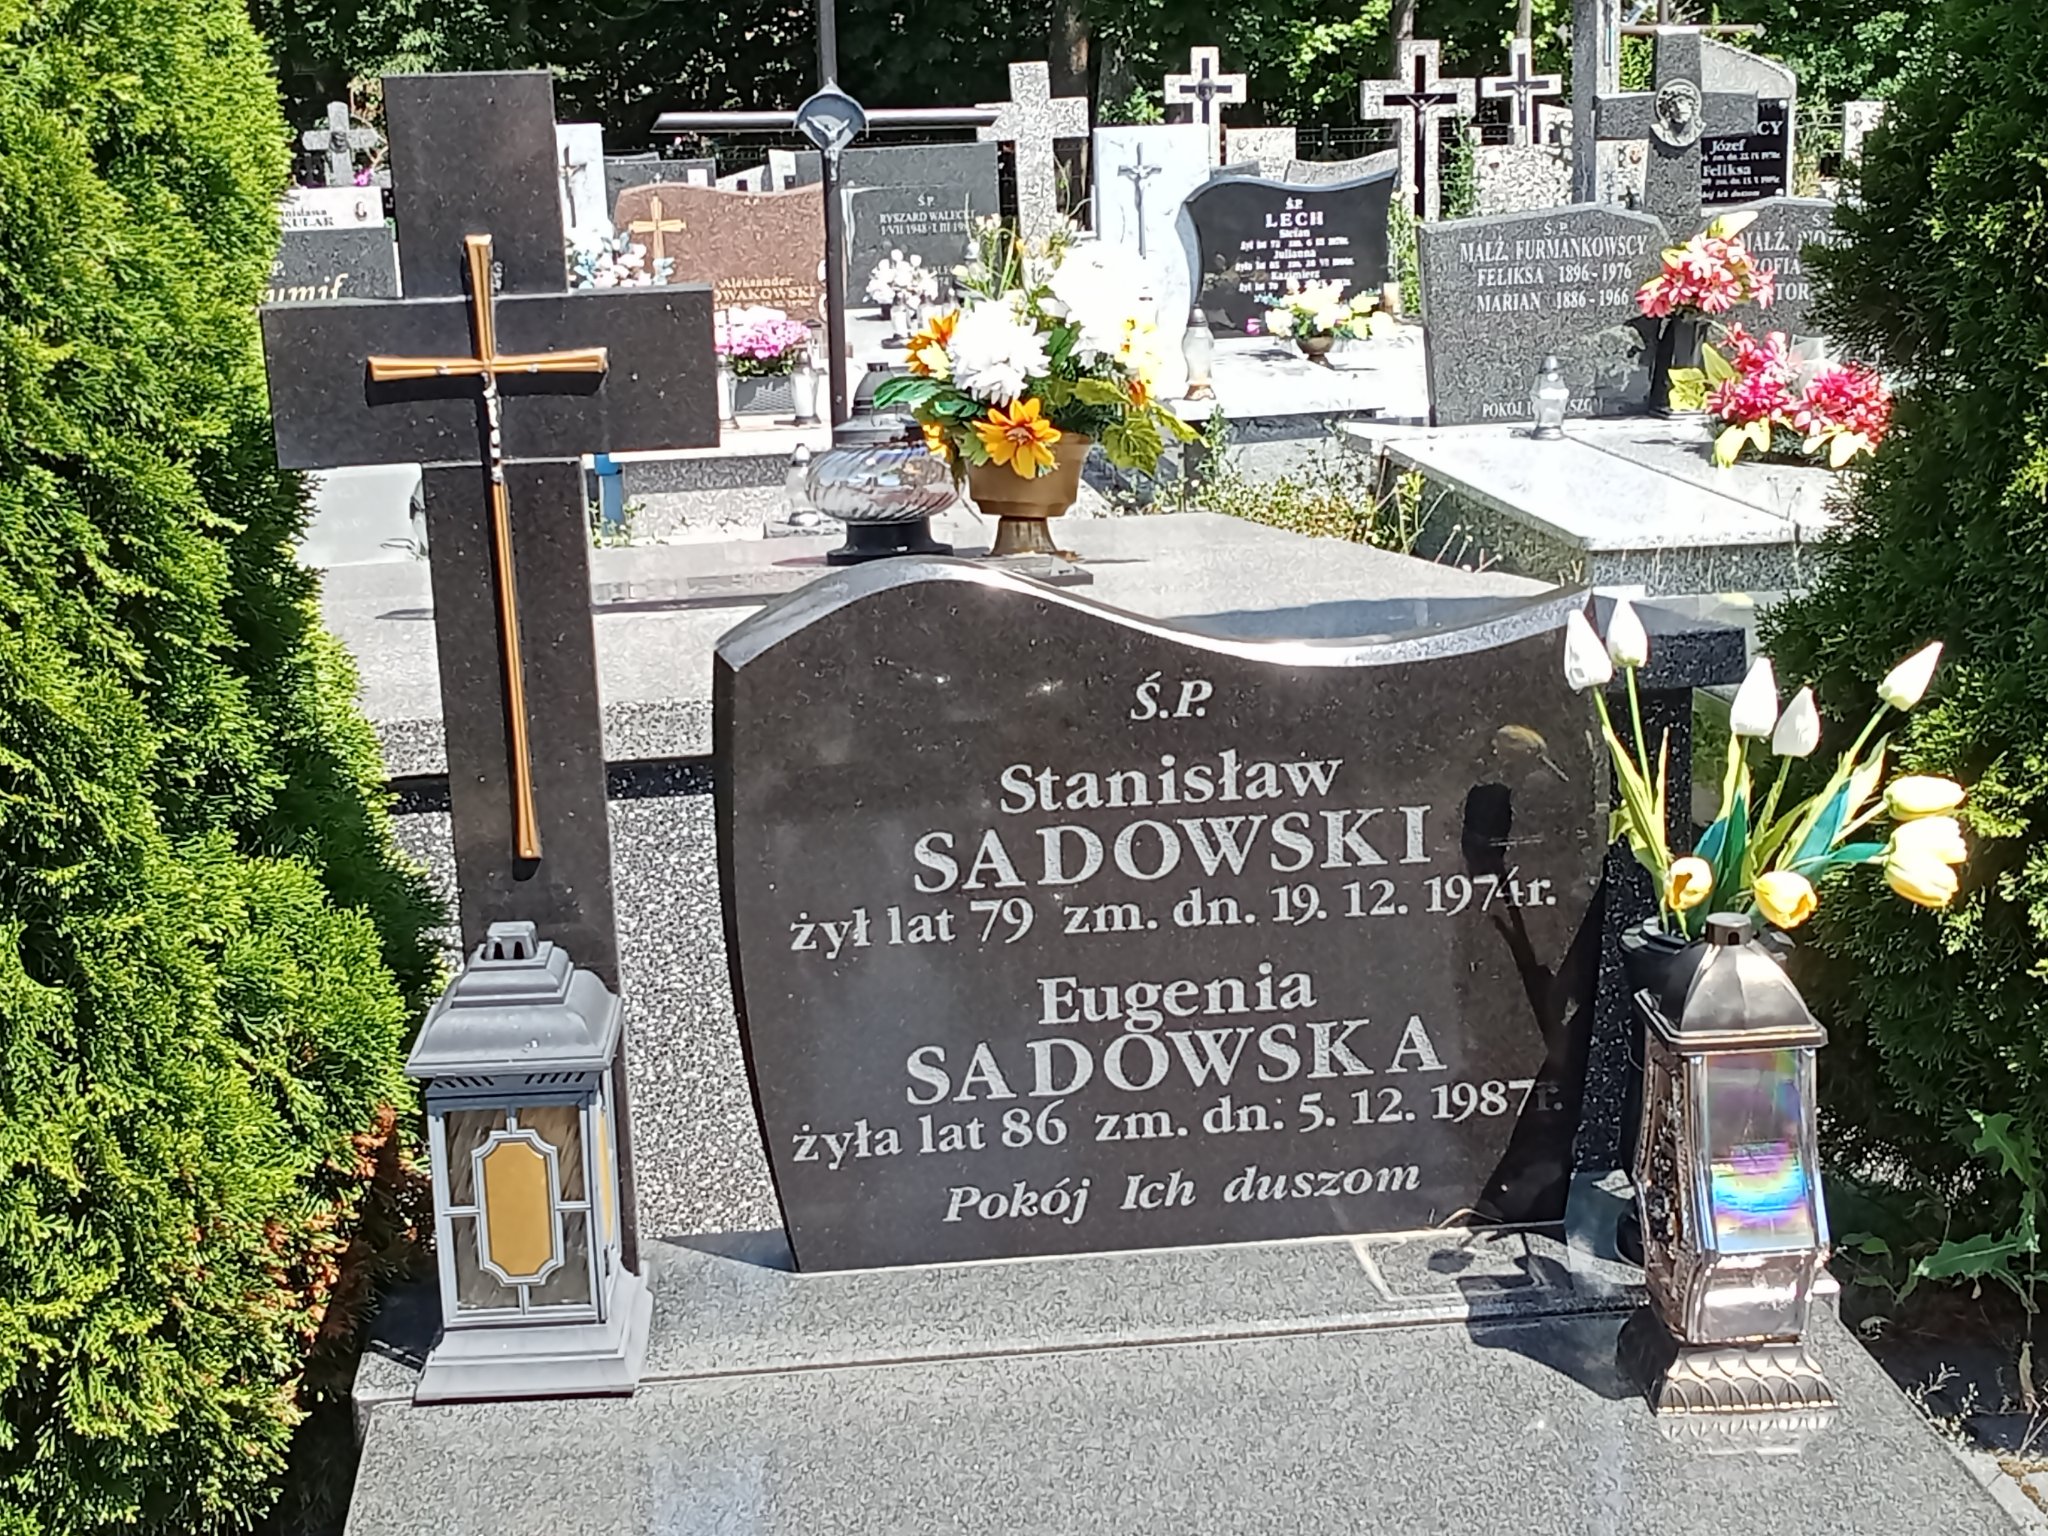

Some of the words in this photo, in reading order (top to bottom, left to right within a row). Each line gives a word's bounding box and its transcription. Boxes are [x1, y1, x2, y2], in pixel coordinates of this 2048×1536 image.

[1710, 139, 1746, 154] Józef
[1703, 164, 1751, 176] Feliksa
[880, 212, 928, 224] RYSZARD
[1266, 212, 1324, 228] LECH
[1516, 234, 1648, 261] FURMANKOWSCY
[1477, 266, 1544, 287] FELIKSA
[1558, 264, 1590, 284] 1896
[1602, 262, 1632, 282] 1976
[714, 286, 817, 302] OWAKOWSKI
[1476, 292, 1542, 314] MARIAN
[1556, 290, 1588, 310] 1886
[1600, 288, 1629, 307] 1966
[1130, 671, 1213, 720] Ś.P.
[1000, 748, 1342, 814] Stanisław
[914, 803, 1433, 894] SADOWSKI
[790, 908, 869, 960] żył
[887, 906, 956, 945] lat
[970, 897, 1034, 945] 79
[1063, 904, 1158, 935] zm.
[1173, 887, 1256, 927] dn.
[1270, 884, 1326, 926] 19.
[1342, 880, 1408, 917] 12.
[1037, 962, 1317, 1033] Eugenia
[906, 1014, 1448, 1106] SADOWSKA
[792, 1120, 903, 1171] żyła
[919, 1114, 986, 1153] lat
[1001, 1106, 1067, 1148] 86
[1094, 1111, 1188, 1142] zm.
[1202, 1095, 1284, 1133] dn.
[1299, 1092, 1336, 1133] 5.
[1351, 1087, 1416, 1124] 12.
[942, 1179, 1090, 1225] Pokój
[1120, 1170, 1196, 1210] Ich
[1223, 1165, 1420, 1203] duszom
